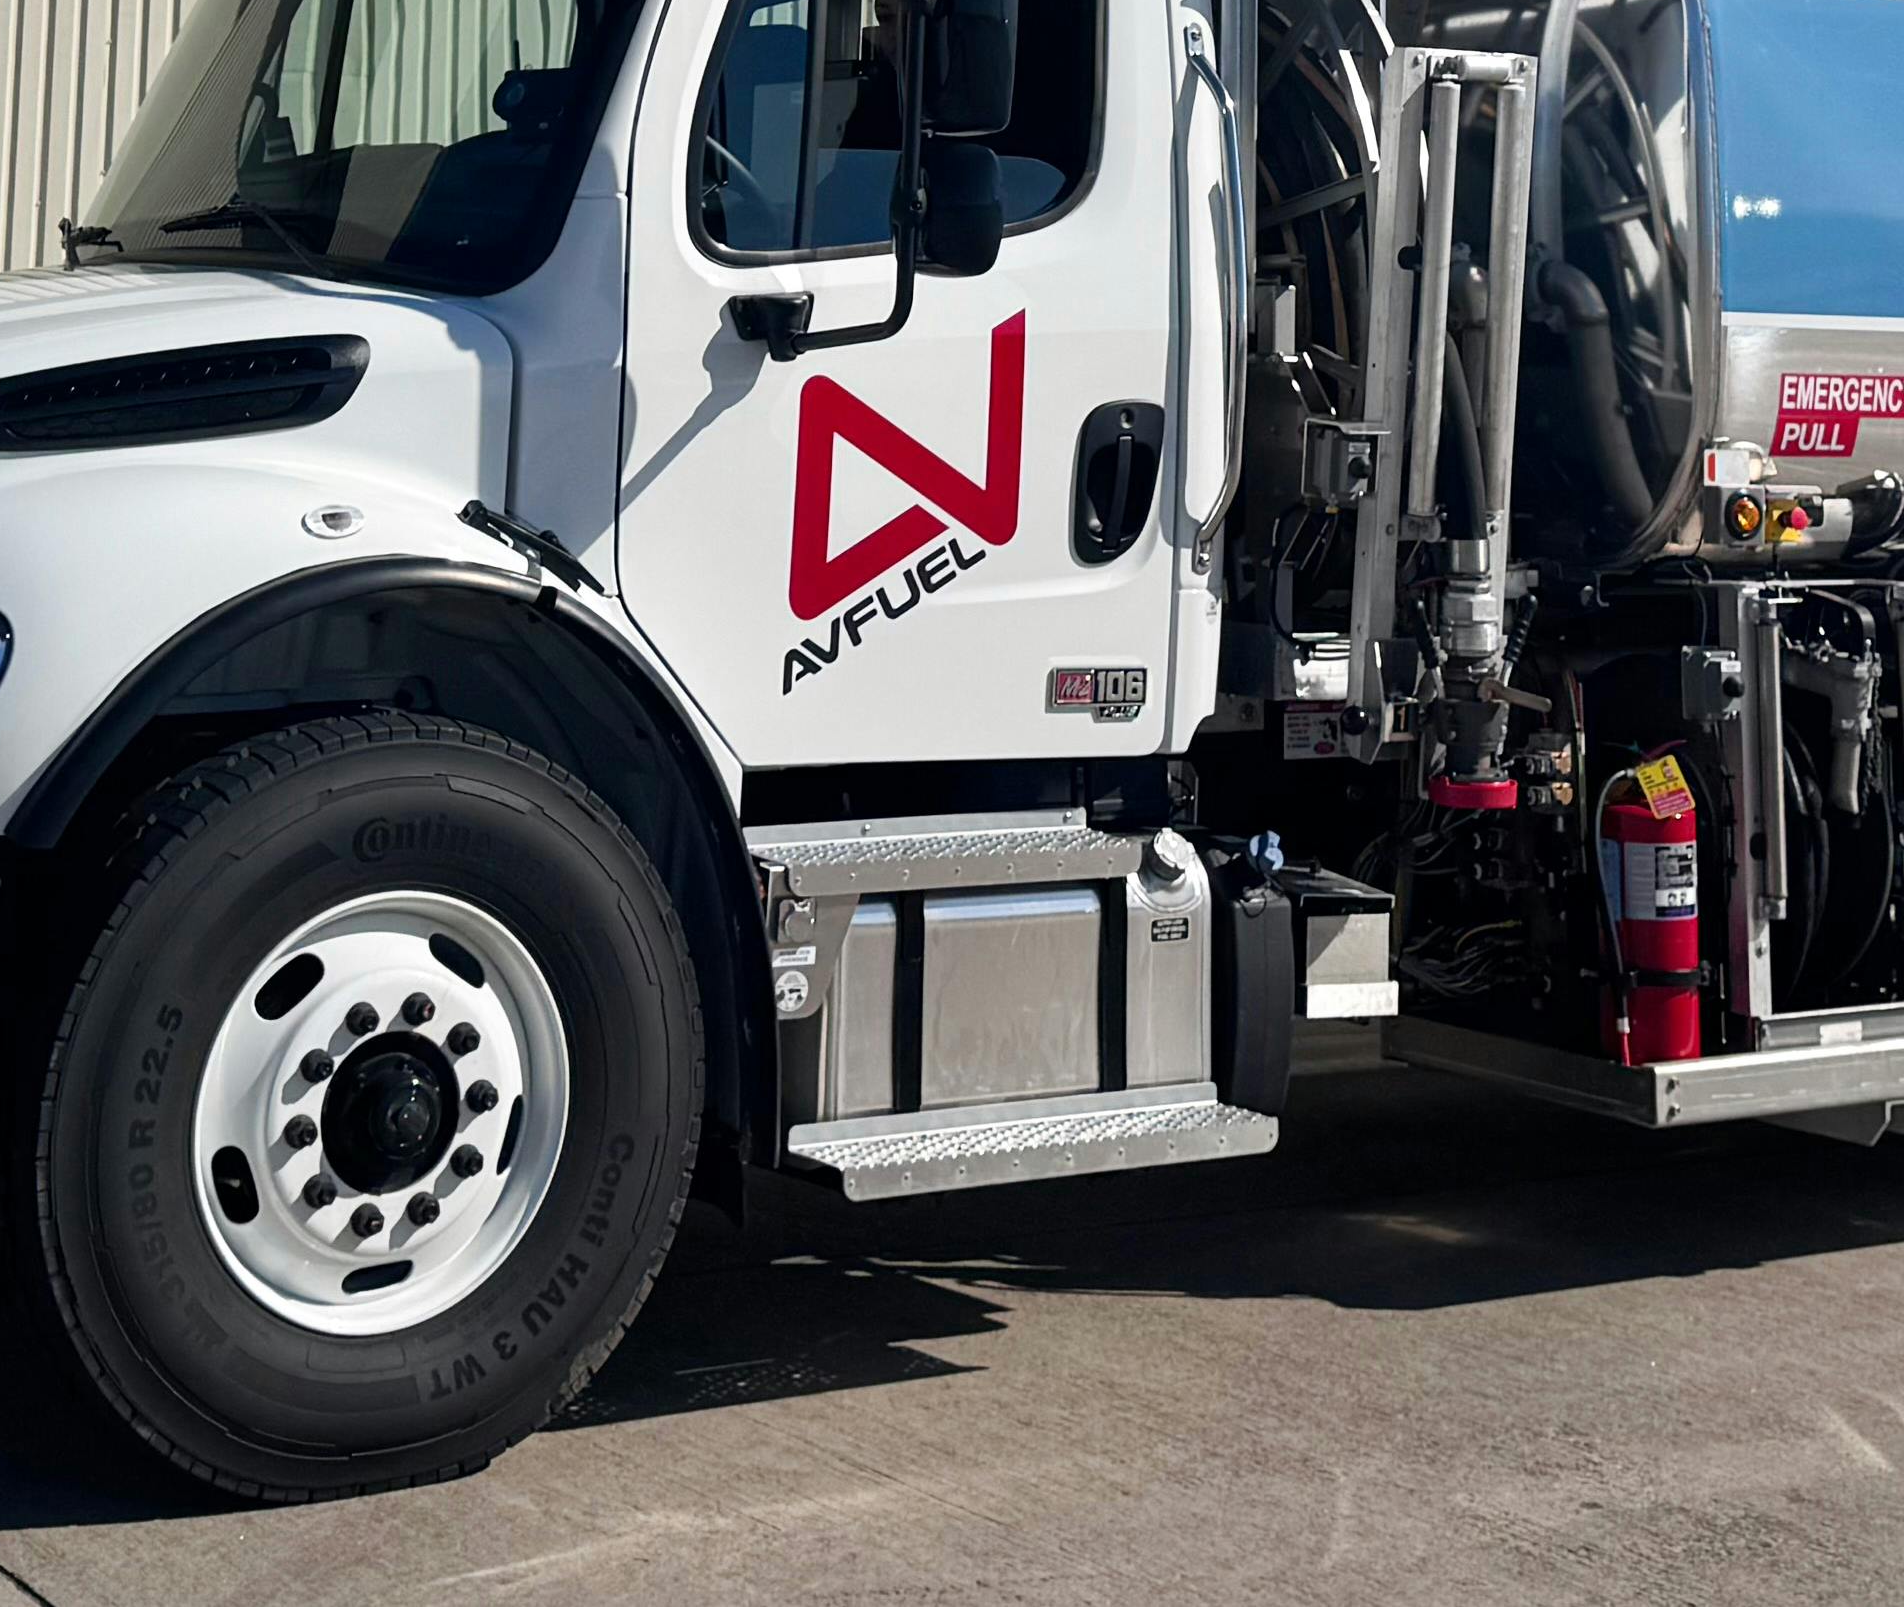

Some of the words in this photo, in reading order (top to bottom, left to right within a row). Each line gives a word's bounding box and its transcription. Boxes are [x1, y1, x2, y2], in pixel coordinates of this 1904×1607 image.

[1780, 423, 1845, 451] PULL
[782, 538, 986, 695] AVFUEL
[1097, 670, 1144, 702] 106
[134, 1003, 183, 1105] 22.5
[129, 1117, 156, 1149] R
[578, 1133, 634, 1247] Conti
[521, 1253, 589, 1337] HAU
[492, 1331, 518, 1361] 3
[431, 1353, 487, 1400] WT
